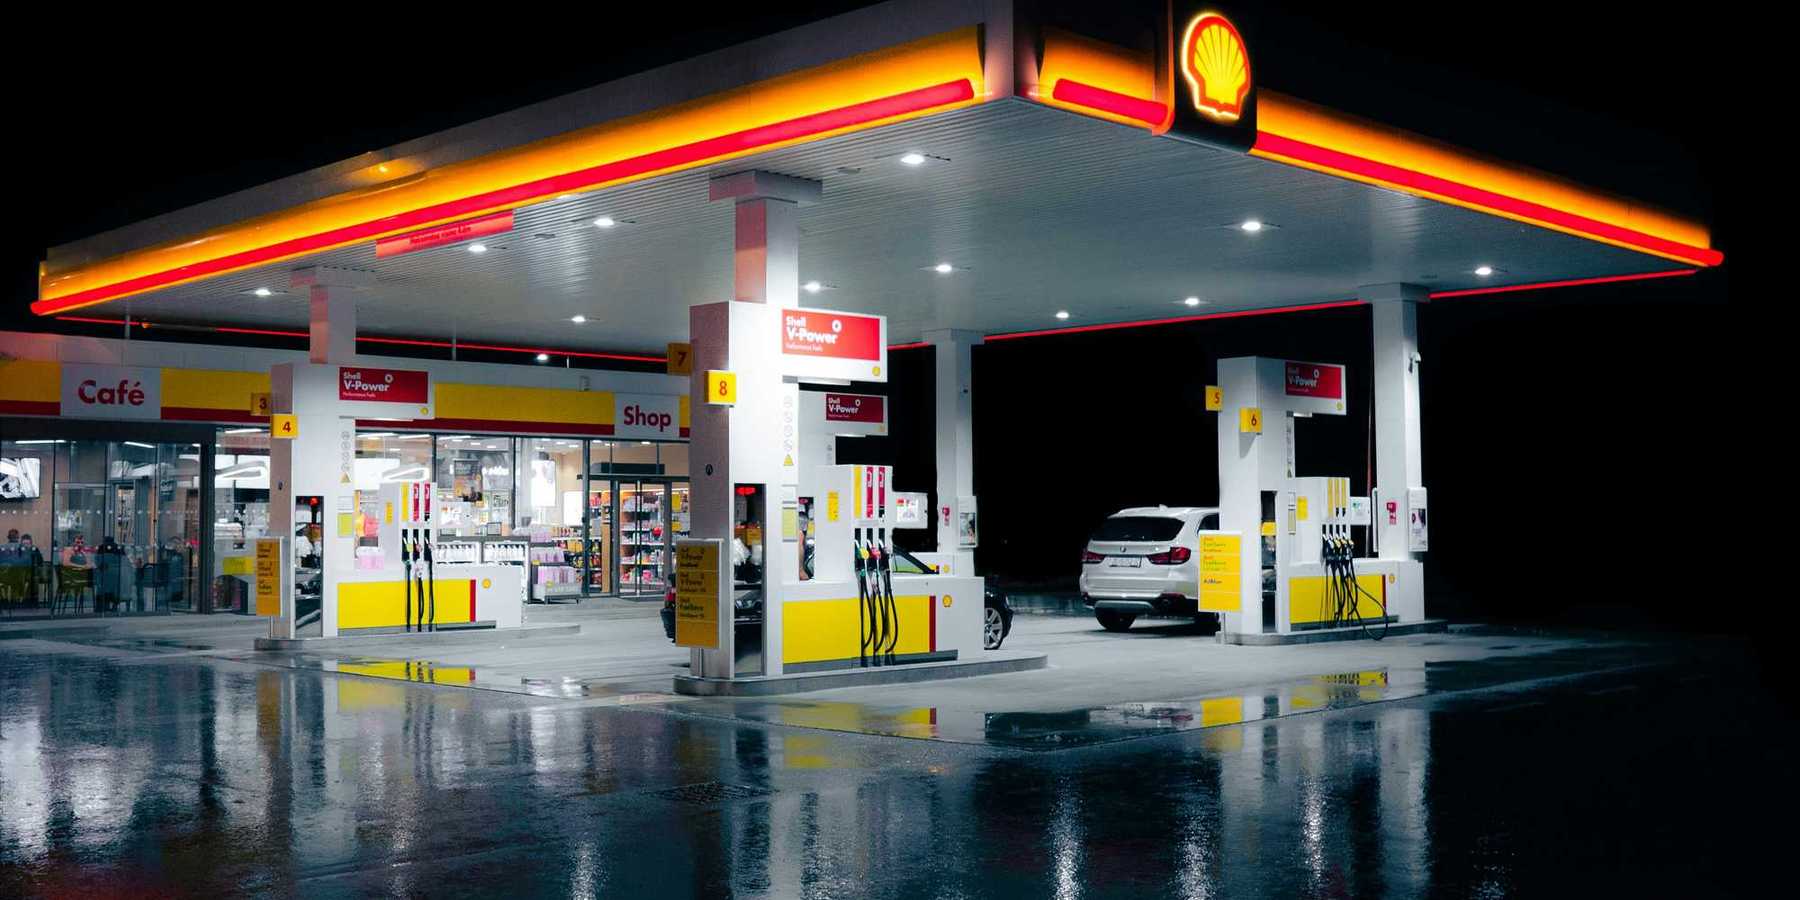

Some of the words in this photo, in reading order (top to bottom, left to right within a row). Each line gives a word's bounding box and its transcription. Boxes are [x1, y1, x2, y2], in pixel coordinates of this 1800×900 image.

[786, 326, 838, 344] V-Power
[677, 352, 687, 367] 7
[343, 371, 361, 380] Shell
[1288, 375, 1318, 388] V-Power
[344, 380, 390, 392] V-Power
[719, 380, 728, 396] 8
[78, 379, 144, 406] Café
[1214, 392, 1220, 404] 5
[259, 398, 267, 409] 3
[828, 404, 859, 414] V-Power
[624, 405, 671, 432] Shop
[1251, 414, 1257, 426] 6
[282, 421, 291, 432] 4
